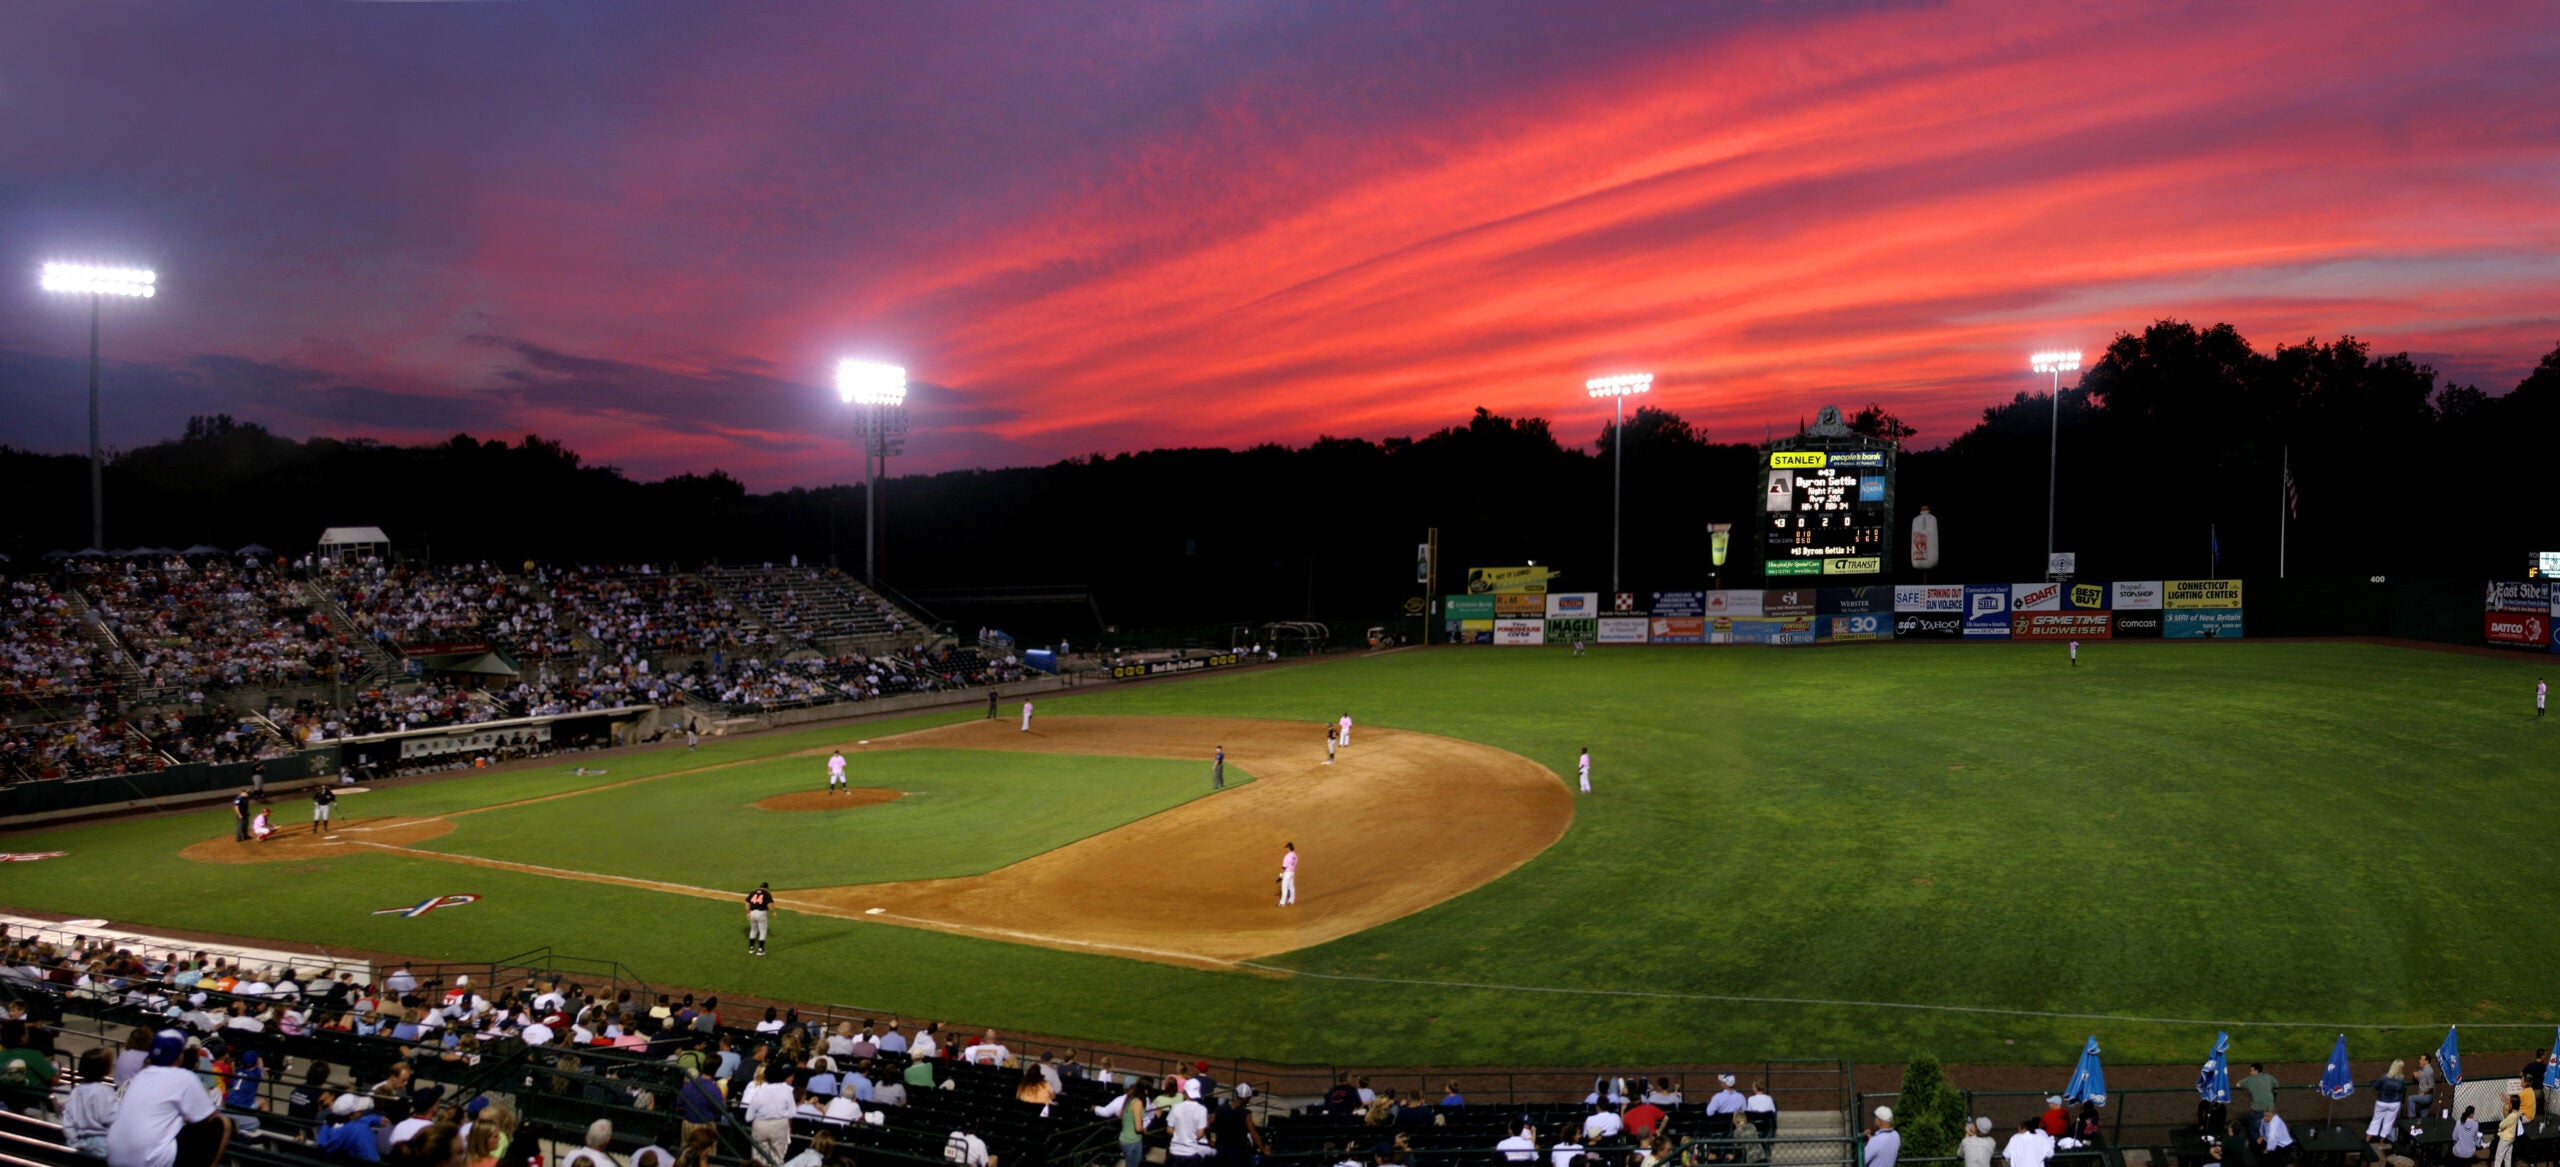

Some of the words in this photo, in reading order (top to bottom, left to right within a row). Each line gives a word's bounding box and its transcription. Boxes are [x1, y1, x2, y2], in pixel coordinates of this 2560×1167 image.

[1774, 456, 1821, 464] STANLEY
[1830, 453, 1860, 462] people's
[1796, 477, 1826, 488] Byron
[1808, 487, 1826, 496] Right
[1828, 487, 1844, 495] Field
[1822, 517, 1828, 526] 2
[1844, 516, 1850, 526] 0
[1802, 547, 1824, 556] Byron
[1835, 560, 1847, 569] CT
[1848, 560, 1877, 569] TRANSIT
[2178, 582, 2228, 590] CONNECTICUT
[2496, 582, 2518, 598] East
[2520, 582, 2540, 599] Side
[1928, 588, 1950, 598] STRIKING
[1952, 588, 1962, 598] OUT
[2024, 584, 2058, 605] EDART
[2076, 588, 2101, 597] BEST
[2168, 590, 2203, 599] LIGHTING
[2206, 590, 2238, 599] CENTERS
[1497, 596, 1502, 604] R
[1510, 596, 1517, 604] M
[1896, 592, 1919, 603] SAFE
[2076, 596, 2098, 604] BUY
[1926, 600, 1937, 609] GUN
[1938, 600, 1962, 609] VIOLENCE
[1978, 600, 1998, 608] SBLI
[2033, 616, 2074, 624] GAME
[2076, 615, 2109, 624] TIME
[2174, 614, 2188, 622] MRI
[1548, 620, 1594, 632] IMAGE!
[1850, 616, 1876, 632] 30
[2120, 619, 2157, 628] comcast
[2491, 622, 2523, 633] DATTCO
[2032, 626, 2106, 634] BUDWEISER
[750, 894, 764, 904] 44
